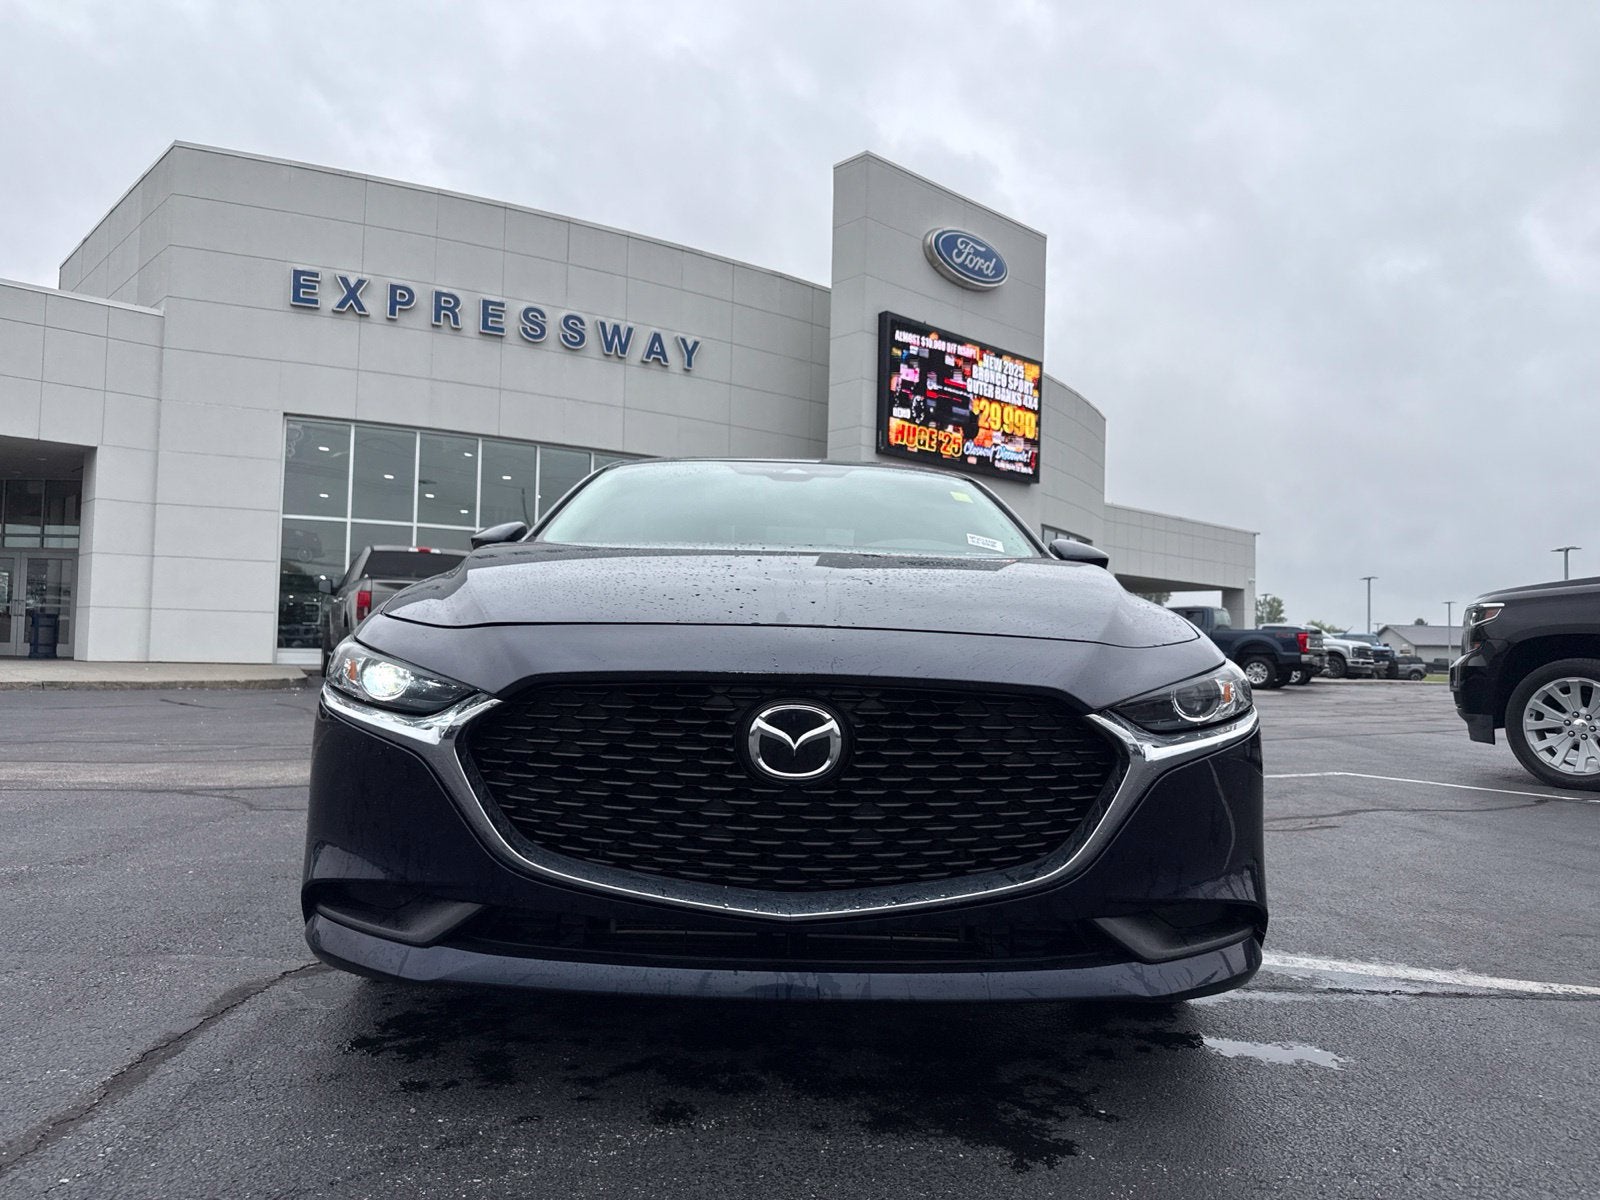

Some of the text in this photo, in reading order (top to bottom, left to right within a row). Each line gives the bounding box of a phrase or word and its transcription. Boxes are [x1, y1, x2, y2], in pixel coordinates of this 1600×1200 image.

[952, 238, 996, 277] Ford
[289, 267, 701, 371] EXPRESSWAY
[895, 329, 920, 347] ALMOST
[946, 342, 957, 354] OFF
[972, 364, 1034, 396] BRONCO SPORT
[982, 353, 1024, 379] NEW 2025
[966, 377, 995, 399] OUTER
[994, 386, 1022, 407] BANKS
[895, 422, 937, 452] HUGE
